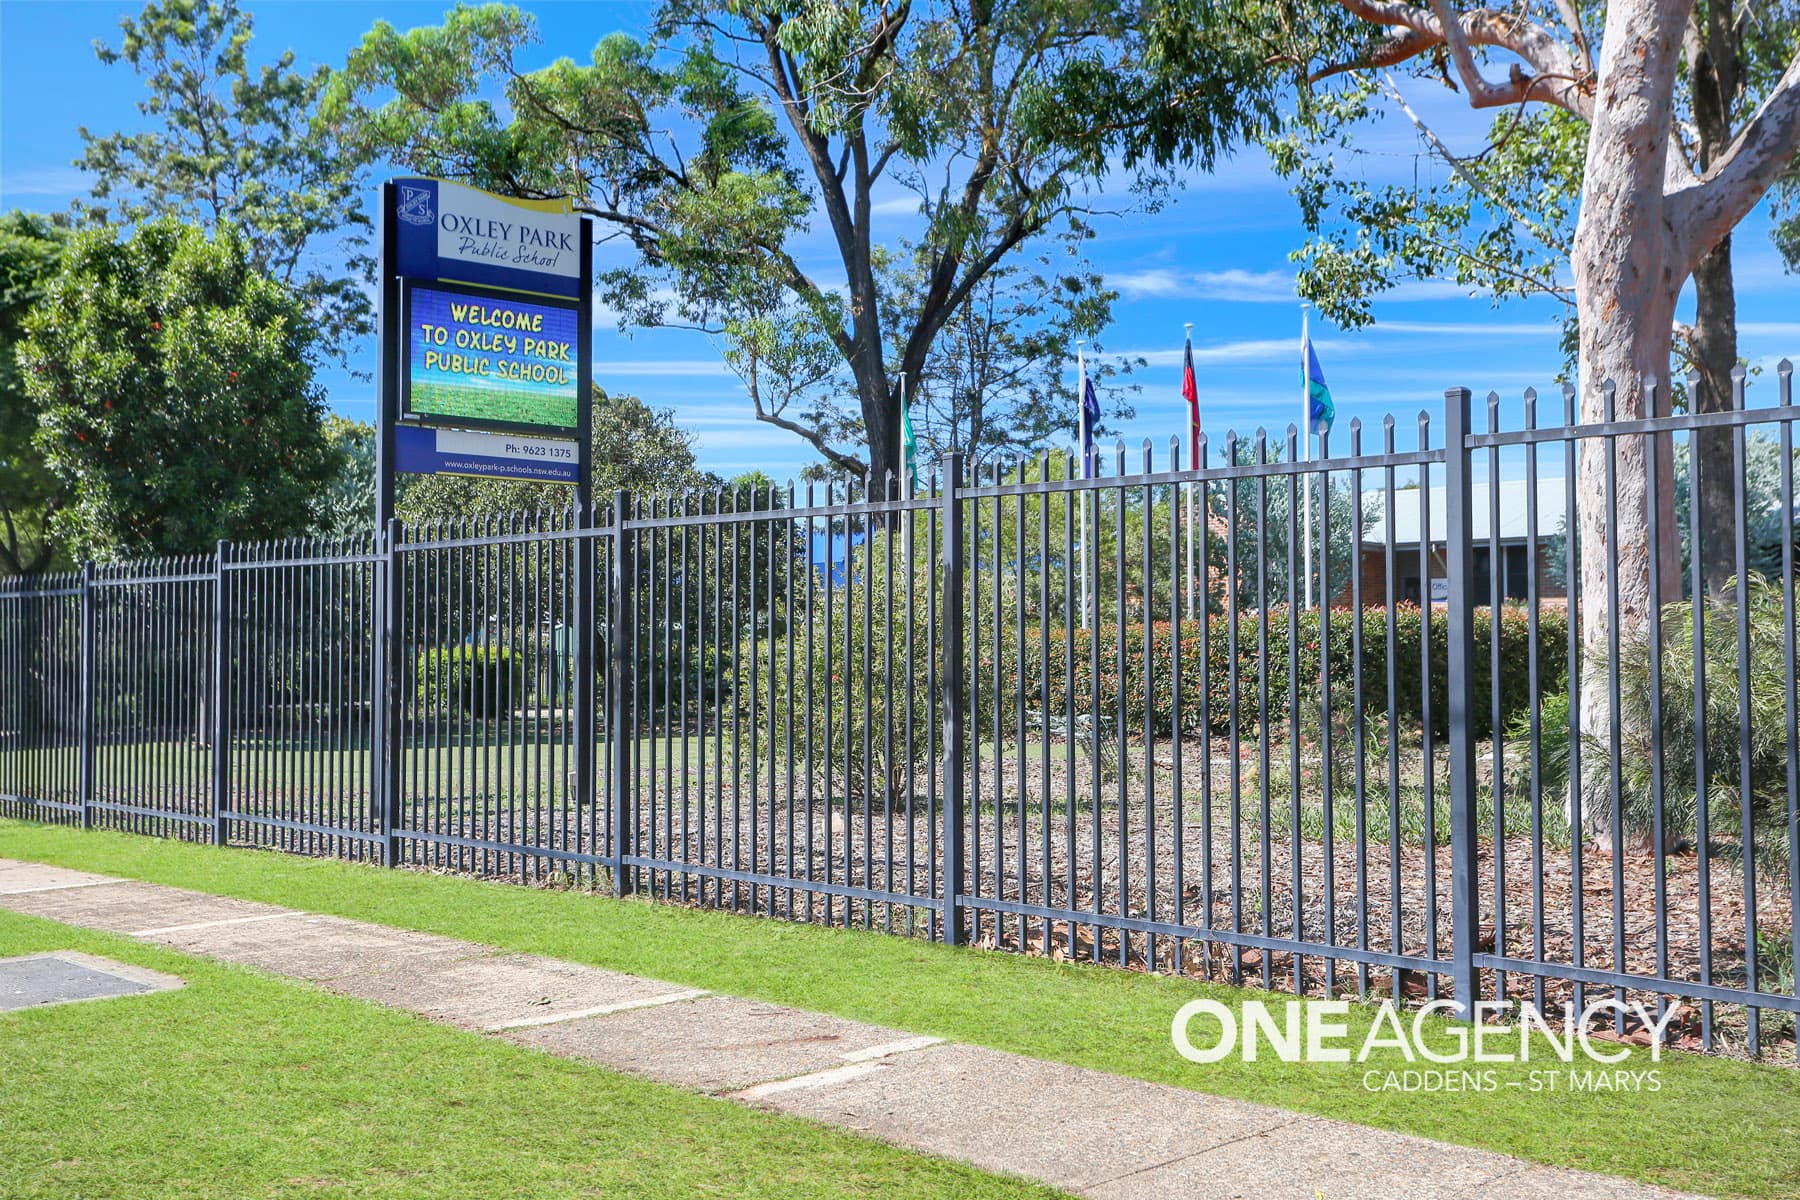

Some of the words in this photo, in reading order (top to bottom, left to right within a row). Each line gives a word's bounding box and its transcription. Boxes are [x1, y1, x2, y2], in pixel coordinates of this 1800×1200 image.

[406, 189, 414, 201] P
[418, 203, 426, 215] S
[441, 213, 512, 241] OXLEY
[520, 226, 574, 251] PARK
[458, 236, 507, 260] Public
[512, 245, 559, 268] School
[450, 302, 544, 332] WELCOME
[421, 324, 449, 345] TO
[455, 329, 517, 354] OXLEY
[523, 337, 571, 361] PARK
[425, 351, 491, 376] PUBLIC
[496, 360, 569, 385] SCHOOL
[505, 443, 521, 454] Ph:
[522, 445, 546, 456] 9623
[549, 447, 571, 458] 1375
[444, 459, 571, 478] www.oxleypark-p.schools.nsw.edu.au
